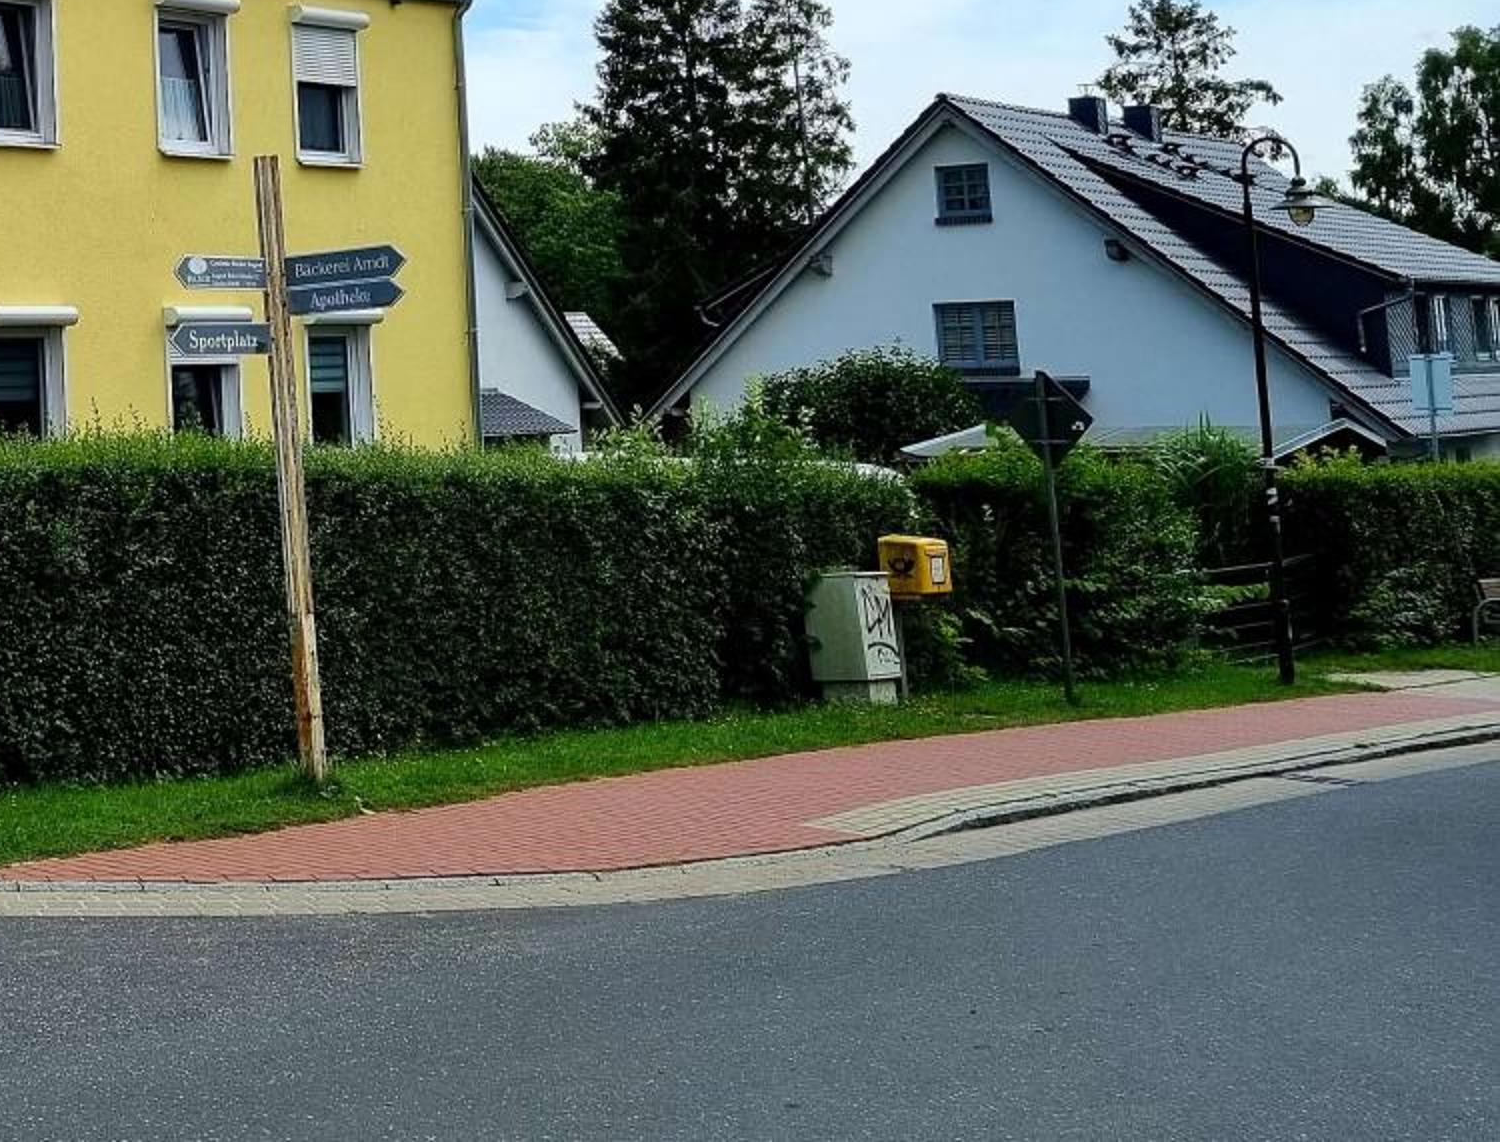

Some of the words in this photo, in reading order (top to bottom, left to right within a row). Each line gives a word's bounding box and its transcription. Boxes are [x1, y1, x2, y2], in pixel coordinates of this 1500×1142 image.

[295, 258, 350, 278] Bäckerei
[353, 255, 389, 272] Arndt
[310, 287, 371, 311] Apotheke
[189, 329, 259, 353] Sportplatz
